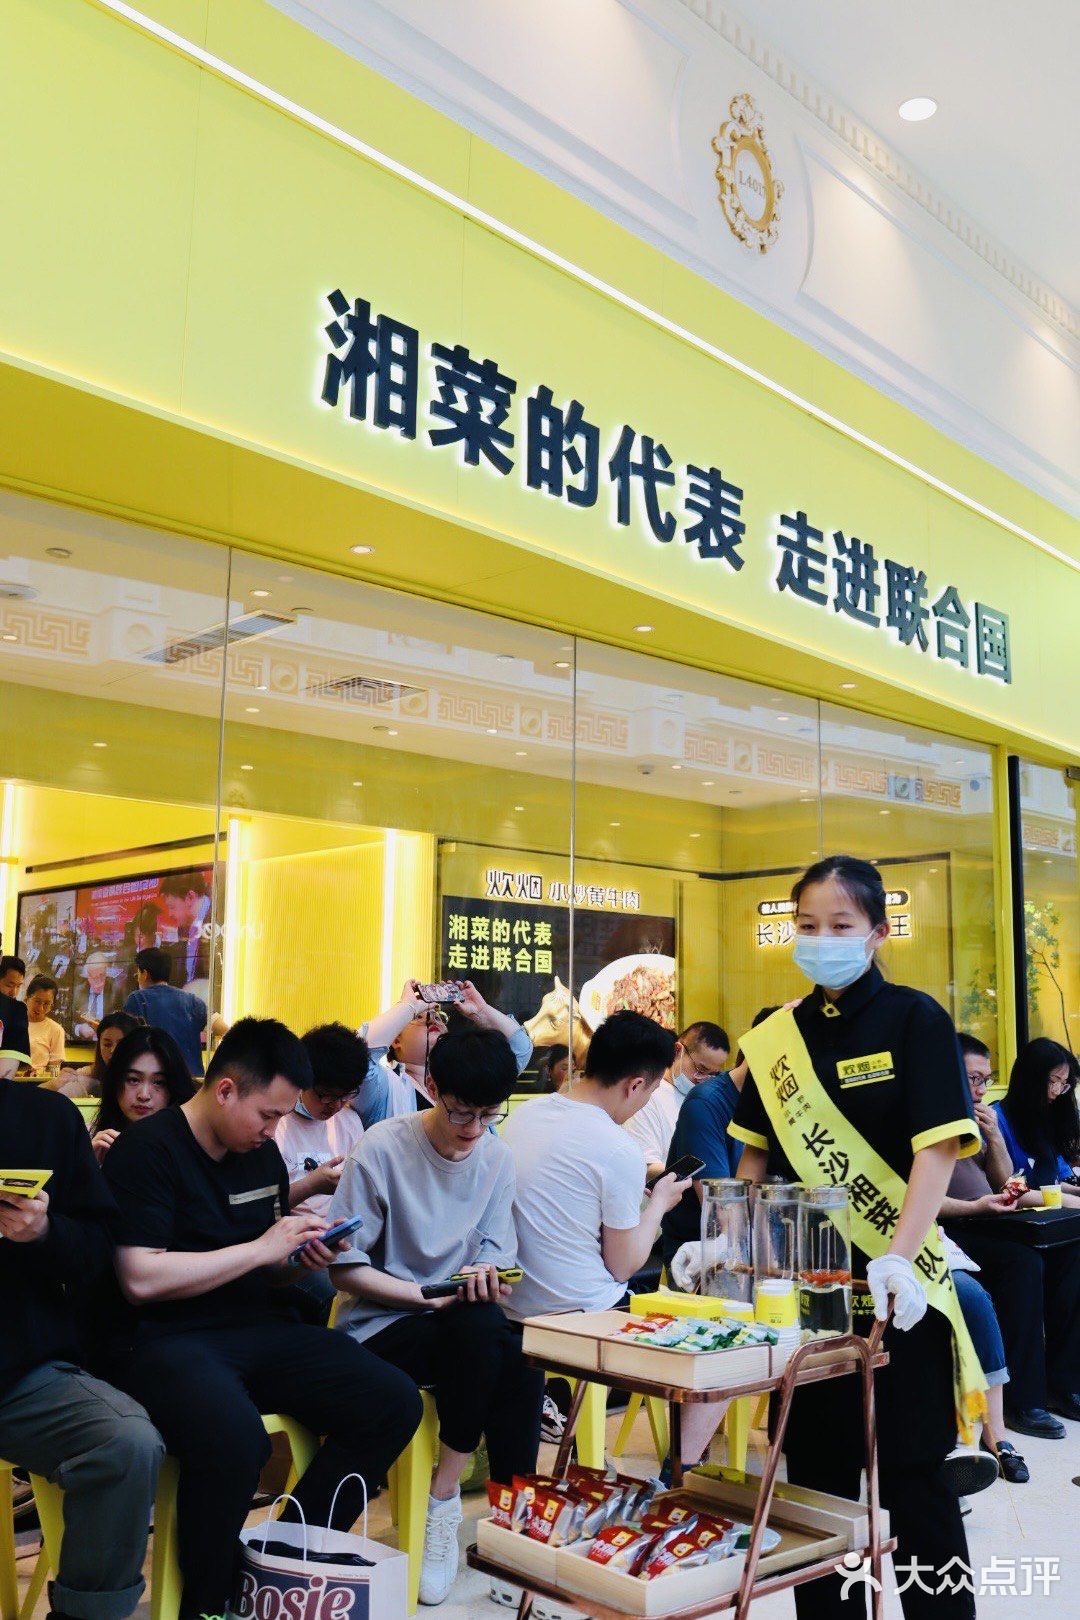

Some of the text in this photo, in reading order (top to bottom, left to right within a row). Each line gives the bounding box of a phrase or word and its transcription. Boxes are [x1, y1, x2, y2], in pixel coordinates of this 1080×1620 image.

[321, 288, 1012, 686] 湘菜的代表 走进联合国
[486, 869, 640, 910] 炊烟 小炒黄牛肉
[448, 914, 552, 947] 湘菜的代表
[448, 944, 553, 974] 走进联合国
[238, 1571, 356, 1620] Bosie
